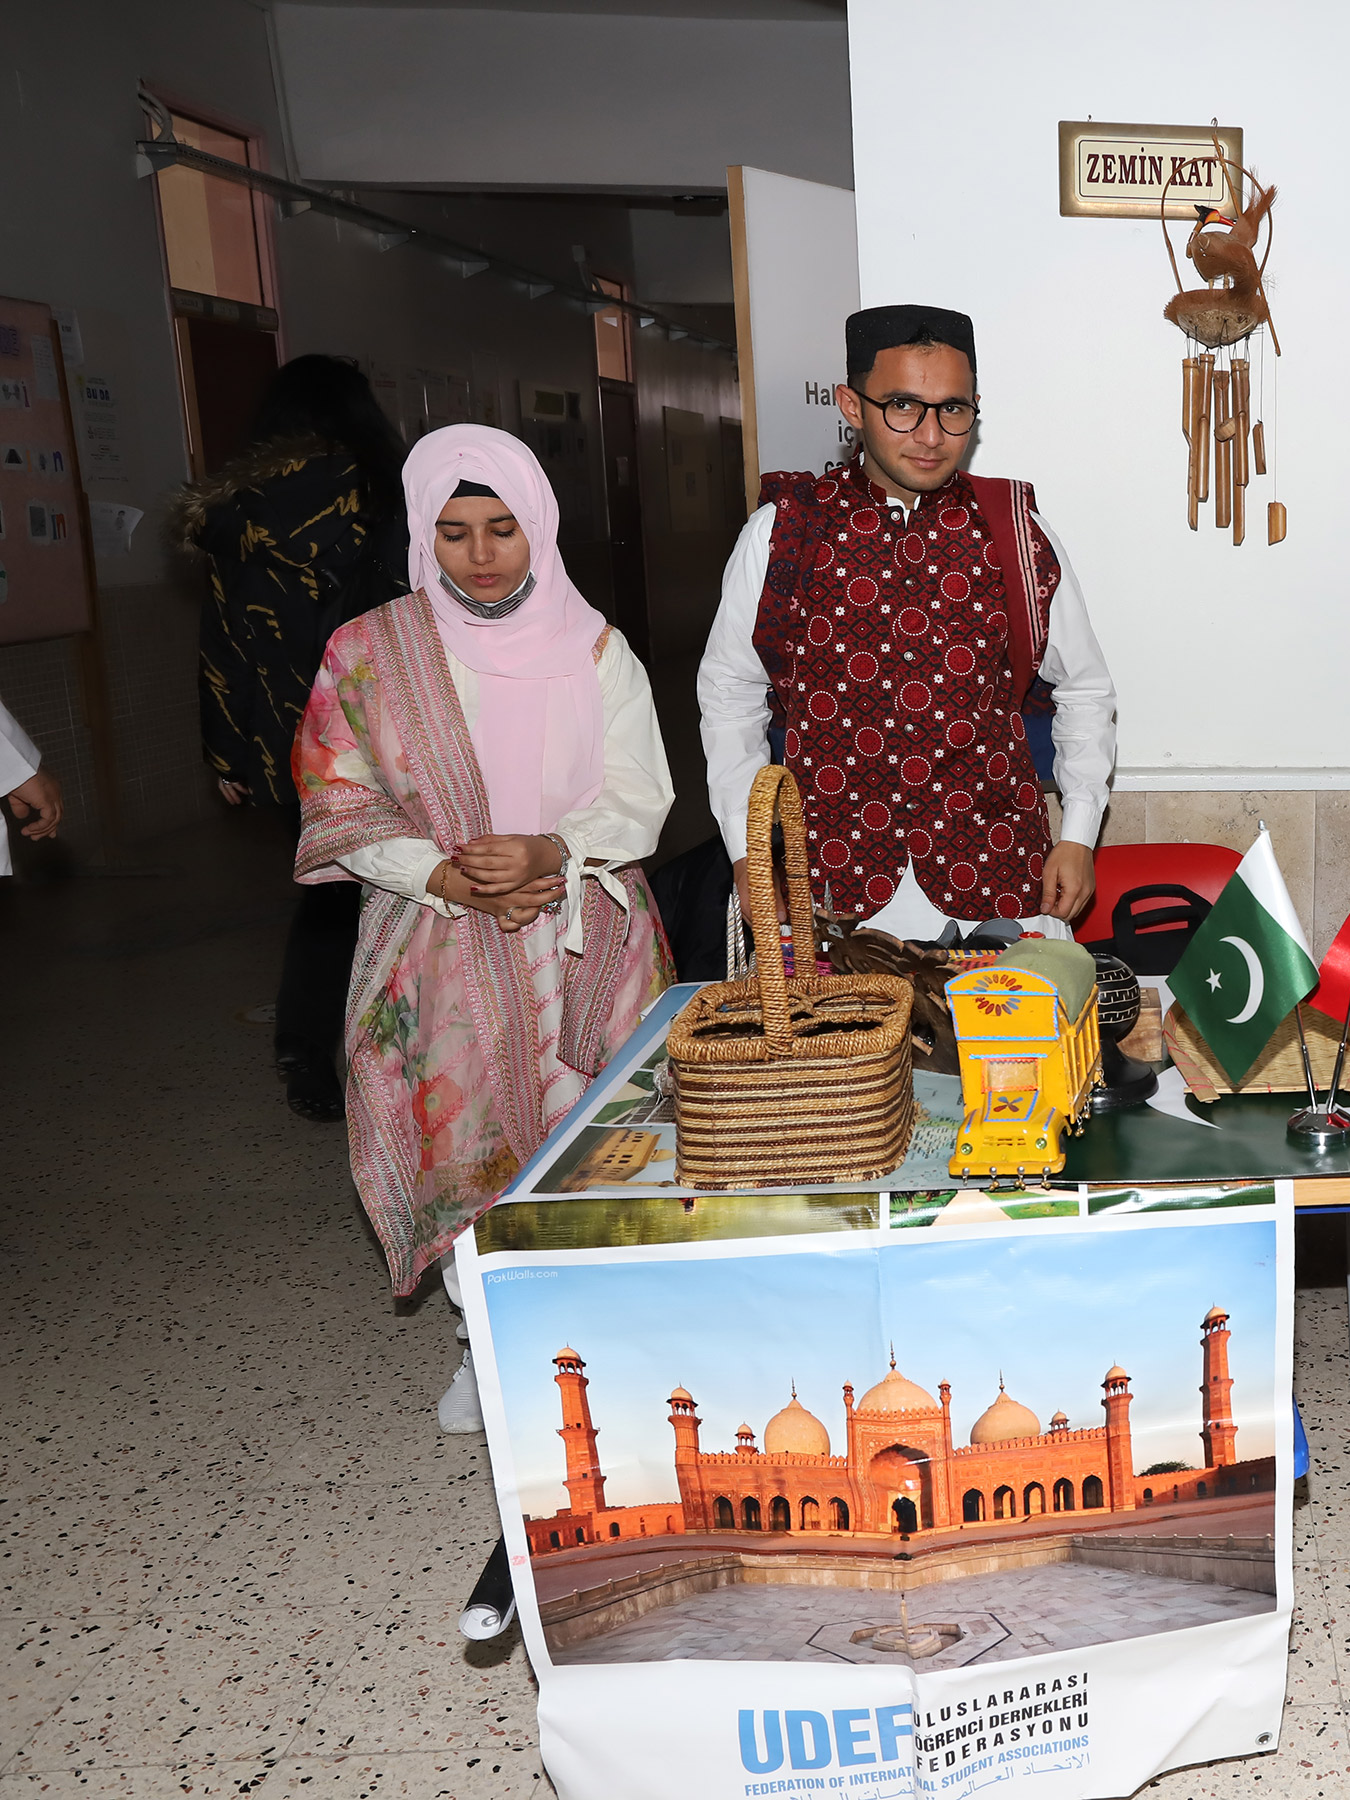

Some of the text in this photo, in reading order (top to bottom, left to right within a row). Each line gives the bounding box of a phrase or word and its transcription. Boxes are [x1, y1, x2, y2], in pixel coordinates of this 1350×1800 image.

[1086, 146, 1217, 187] ZEMİN KAT
[805, 381, 836, 406] Hal
[838, 420, 854, 448] iç
[487, 1269, 558, 1285] PakWalls.com
[914, 1672, 1088, 1728] ULUSLARARASI
[915, 1689, 1088, 1753] ÖĞRENCİ DERNEKLERİ
[738, 1703, 912, 1775] UDEF
[745, 1778, 825, 1797] FEDERATION
[829, 1776, 846, 1789] OF
[941, 1755, 994, 1789] STUDENT
[998, 1734, 1089, 1764] ASSOCIATIONS
[916, 1712, 1089, 1773] FEDERASYONU
